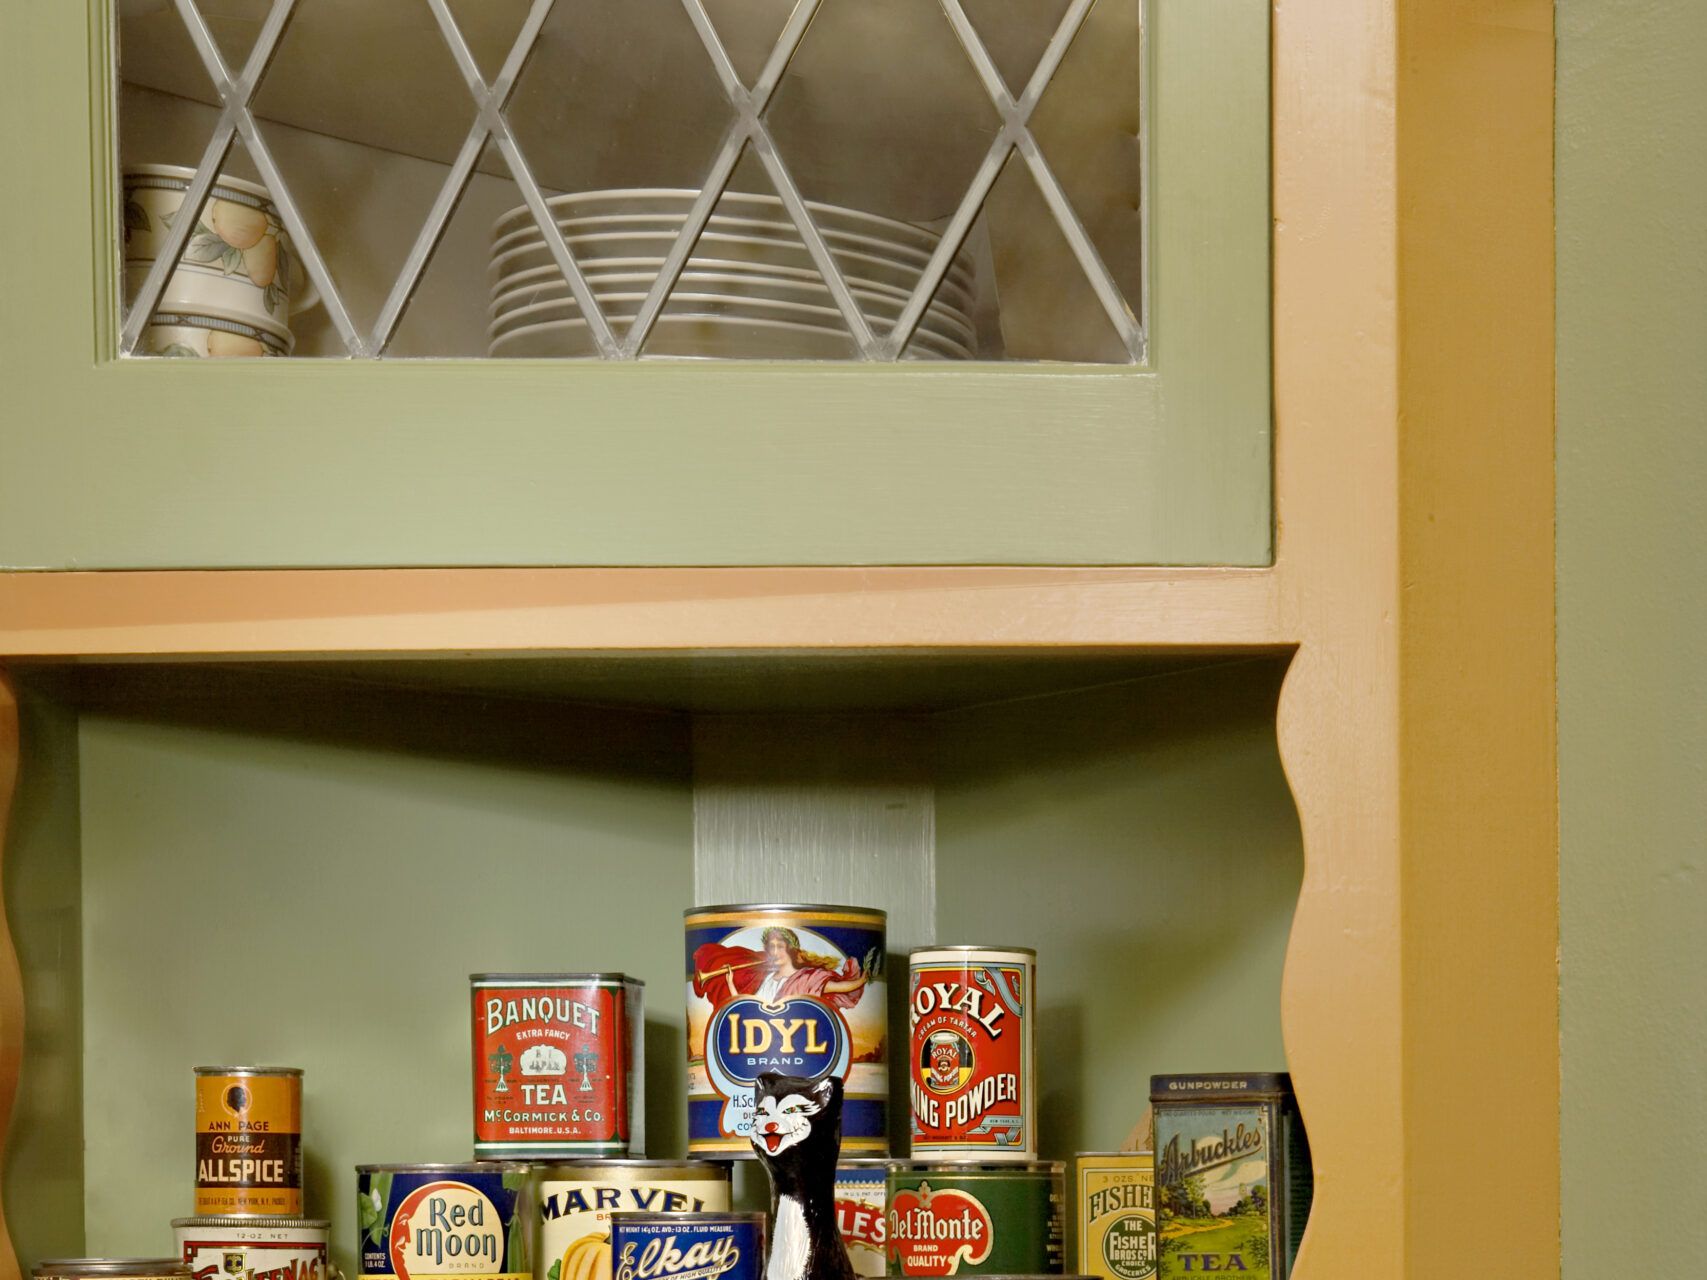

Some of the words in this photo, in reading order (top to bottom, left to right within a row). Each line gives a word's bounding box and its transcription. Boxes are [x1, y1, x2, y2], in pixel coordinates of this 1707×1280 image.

[486, 996, 600, 1036] BANQUET
[910, 982, 1005, 1039] ROYAL
[728, 1013, 828, 1054] IDYL
[917, 1019, 936, 1040] CREAM
[937, 1016, 948, 1024] OF
[949, 1016, 978, 1038] TARTAR
[516, 1029, 543, 1041] EXTRA
[544, 1029, 571, 1041] FANCY
[747, 1057, 804, 1065] BRAND
[1168, 1081, 1248, 1090] GUNPOWDER
[521, 1084, 568, 1105] TEA
[945, 1072, 1018, 1128] POWDER
[571, 1109, 580, 1122] &
[208, 1121, 231, 1131] ANN
[238, 1121, 269, 1131] PAGE
[211, 1135, 265, 1154] Ground
[198, 1159, 284, 1182] ALLSPICE
[1141, 1174, 1154, 1182] NE
[430, 1197, 483, 1232] Red
[1124, 1220, 1142, 1231] THE
[913, 1244, 938, 1252] BRAND
[1114, 1249, 1136, 1261] BROS
[907, 1256, 948, 1268] QUALITY
[1177, 1253, 1248, 1272] TEA
[680, 1272, 697, 1280] HIGH
[1115, 1264, 1151, 1276] GROCERIES
